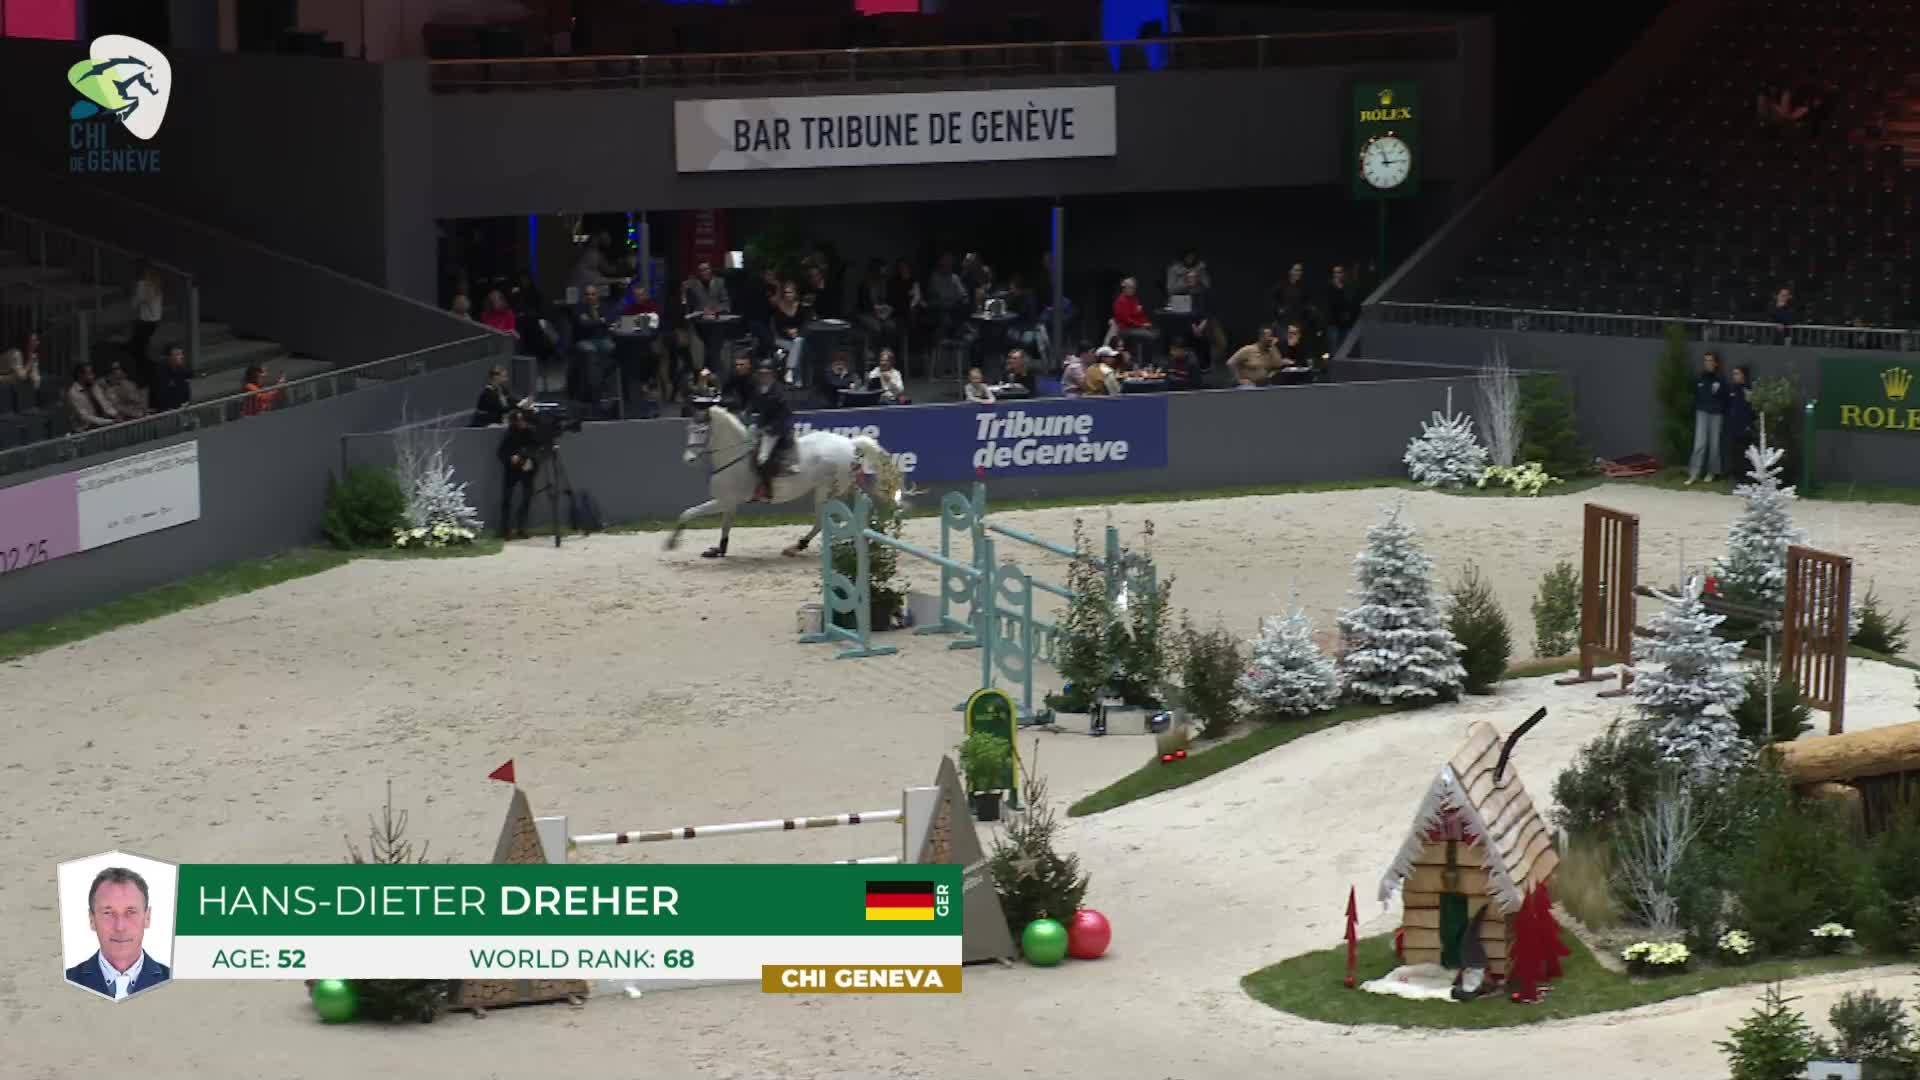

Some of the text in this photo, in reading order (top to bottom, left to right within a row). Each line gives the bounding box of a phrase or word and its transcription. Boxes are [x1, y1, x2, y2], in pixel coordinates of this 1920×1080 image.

[734, 101, 1076, 152] BAR TRIBUNE DE GENÈVE
[1360, 107, 1411, 121] ROLEX
[975, 411, 1094, 441] Tribune
[973, 438, 1129, 469] deGenève
